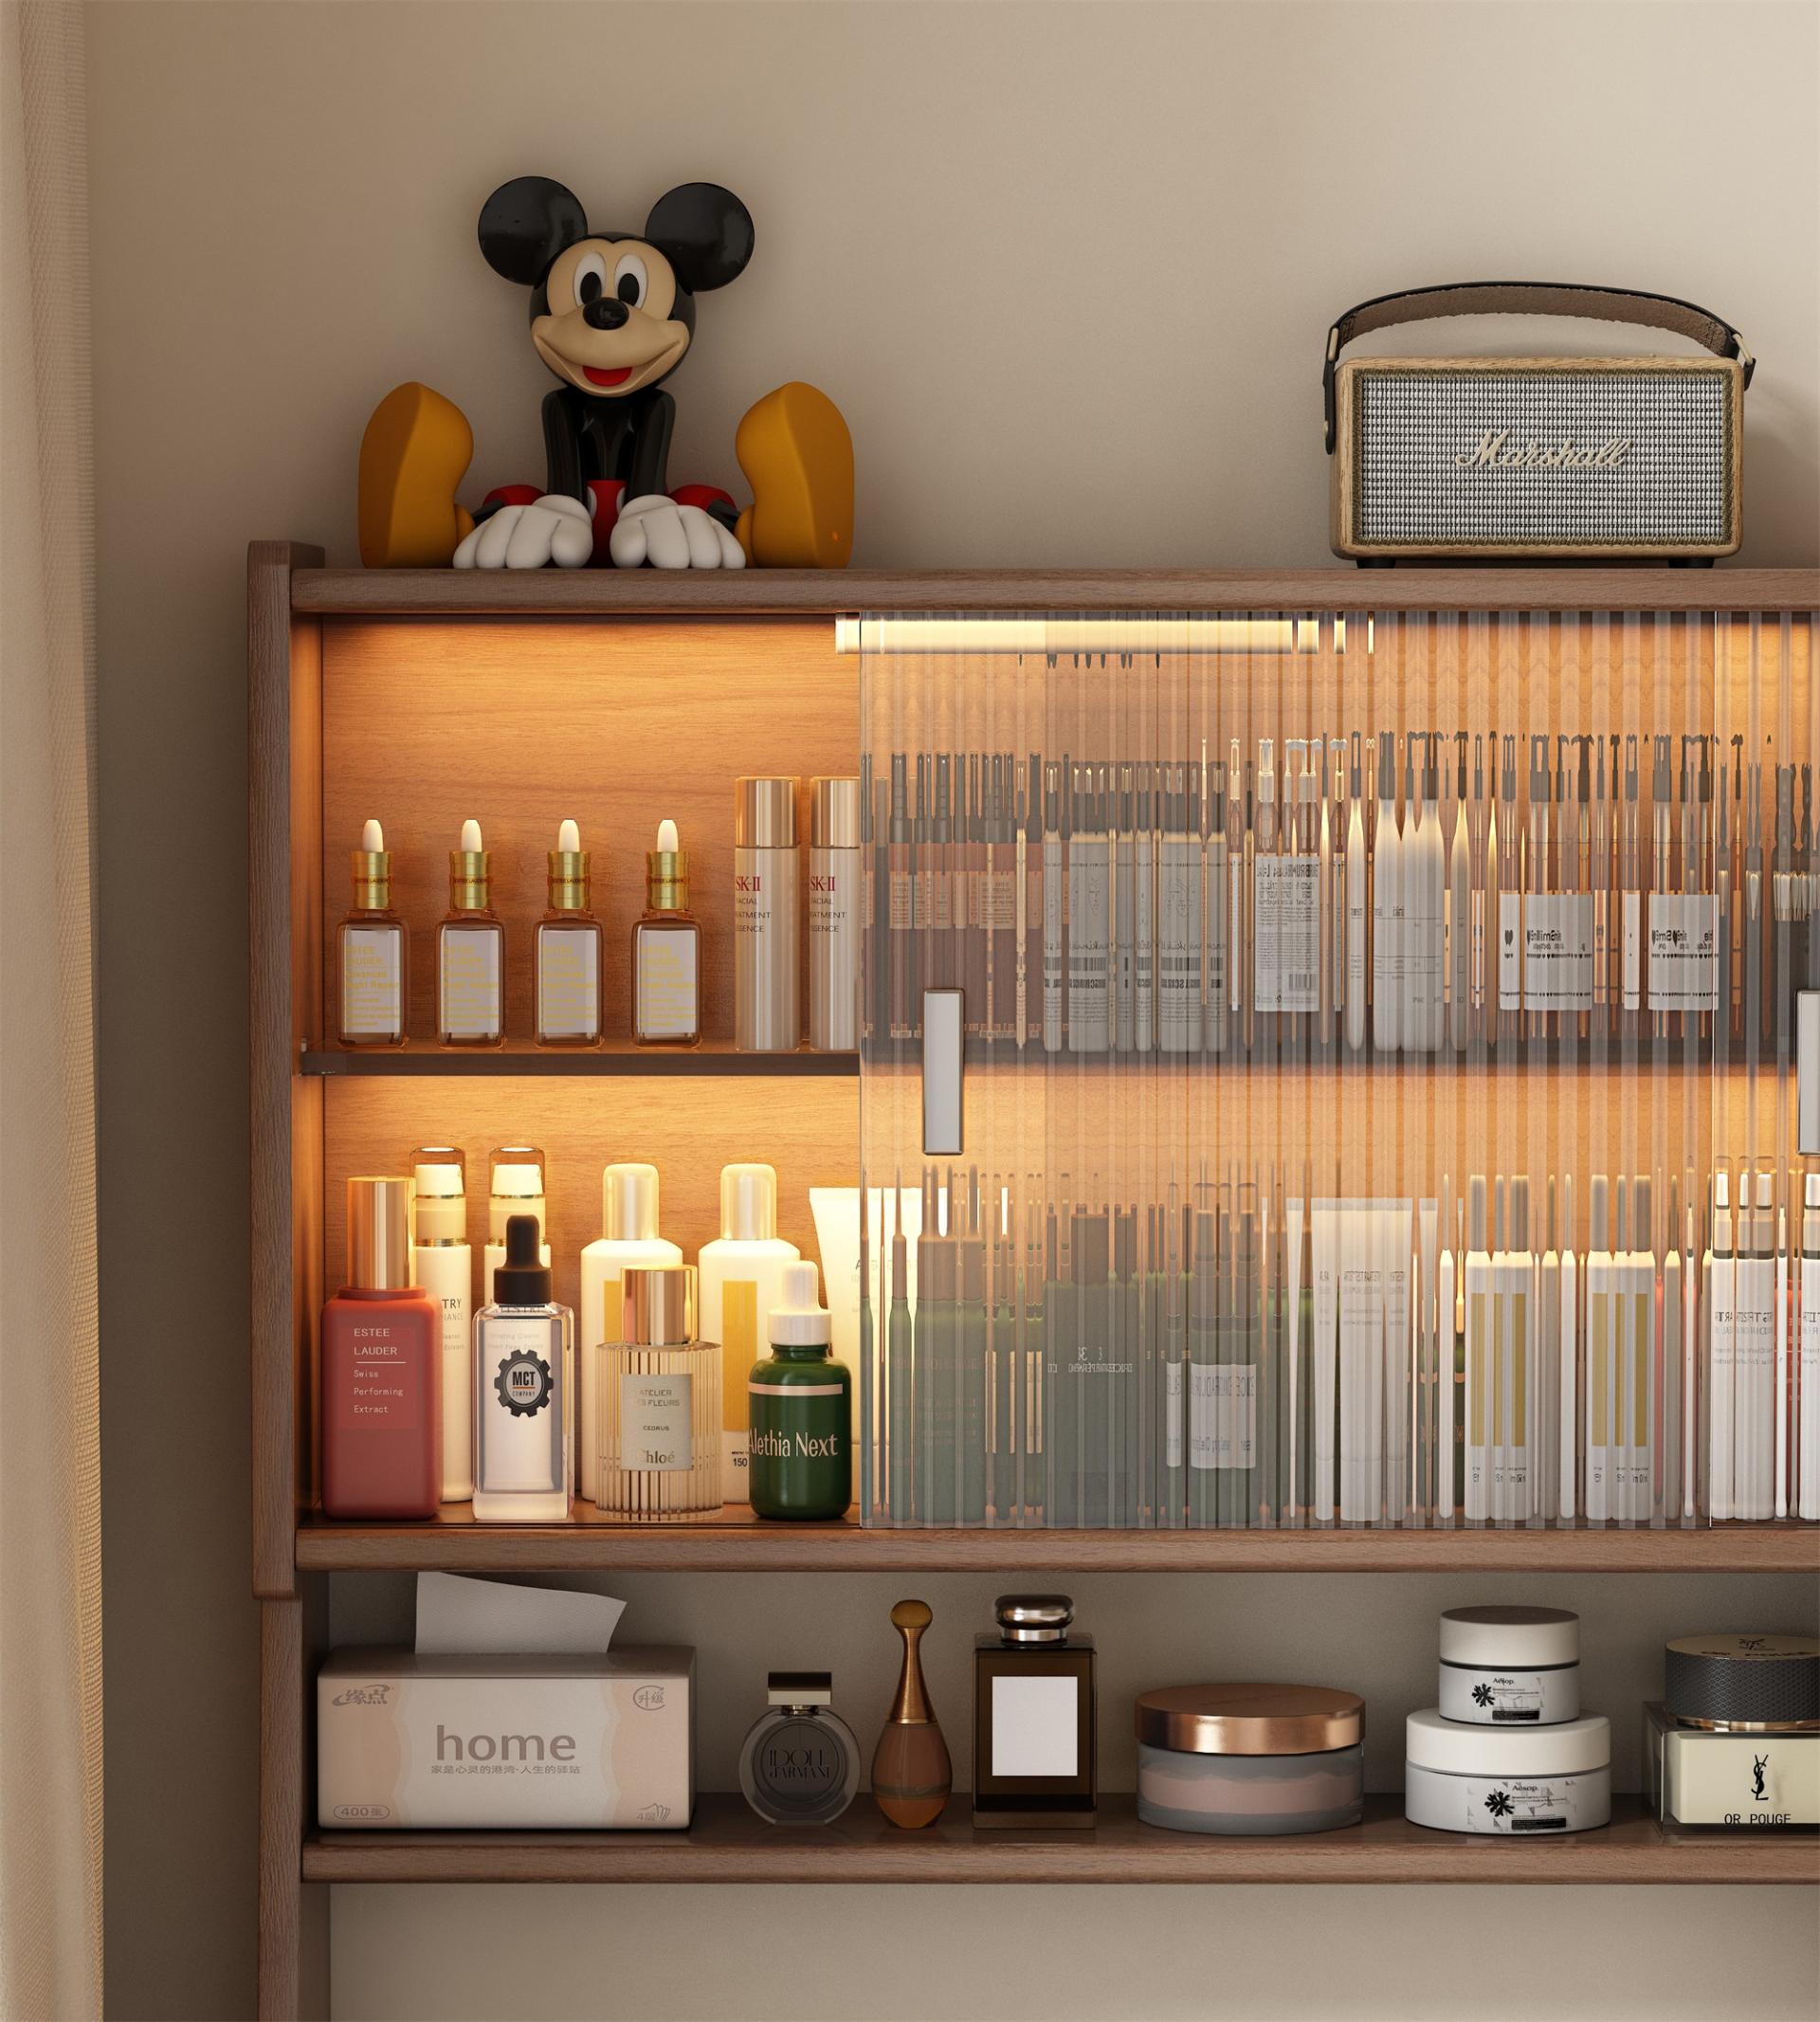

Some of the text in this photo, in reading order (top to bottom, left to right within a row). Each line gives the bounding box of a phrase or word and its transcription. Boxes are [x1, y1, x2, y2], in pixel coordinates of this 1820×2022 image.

[1455, 428, 1632, 467] Marshall
[736, 876, 761, 892] SK-II
[810, 876, 836, 892] SK-II
[354, 1328, 391, 1337] ESTEE
[354, 1346, 398, 1356] LAUDER
[354, 1369, 379, 1377] Swiss
[513, 1371, 536, 1386] MCT
[354, 1387, 404, 1397] Performing
[354, 1405, 388, 1413] Extract
[749, 1428, 839, 1457] Alethia Next
[638, 1449, 675, 1464] hloé
[733, 1457, 748, 1467] 150
[436, 1724, 576, 1761] home
[1723, 1813, 1741, 1826] OR
